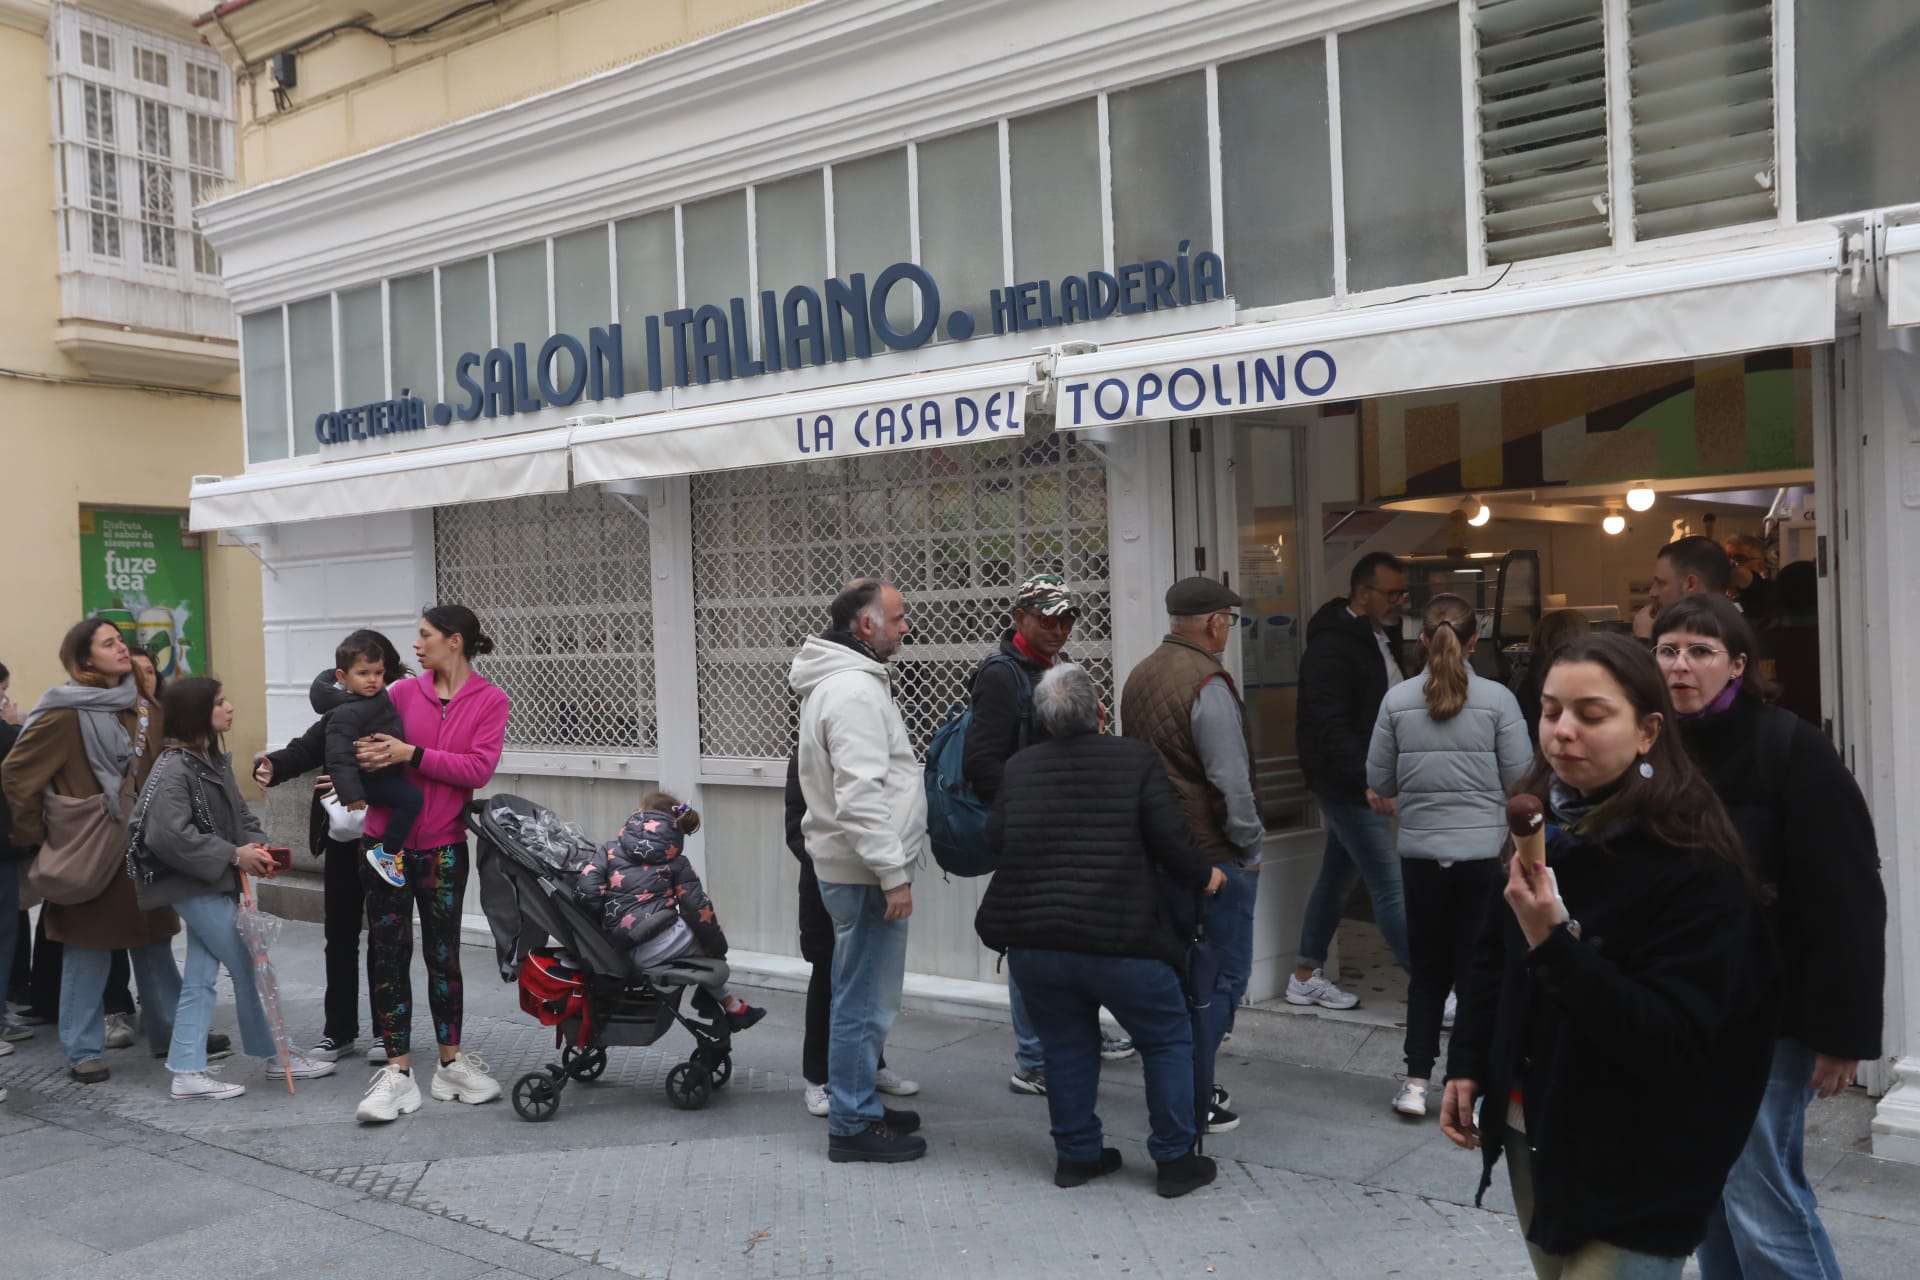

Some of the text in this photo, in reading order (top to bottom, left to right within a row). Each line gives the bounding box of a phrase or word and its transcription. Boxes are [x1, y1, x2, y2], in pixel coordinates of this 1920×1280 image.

[315, 239, 1225, 445] CAFETERÍA SALON ITALIANO HELADERÍA
[797, 349, 1337, 453] LA CASA DEL TOPOLINO
[103, 519, 142, 530] Disfruta
[114, 529, 139, 539] sabor
[142, 529, 153, 540] de
[103, 538, 142, 550] siempre
[104, 550, 157, 574] fuze
[105, 571, 145, 591] tea
